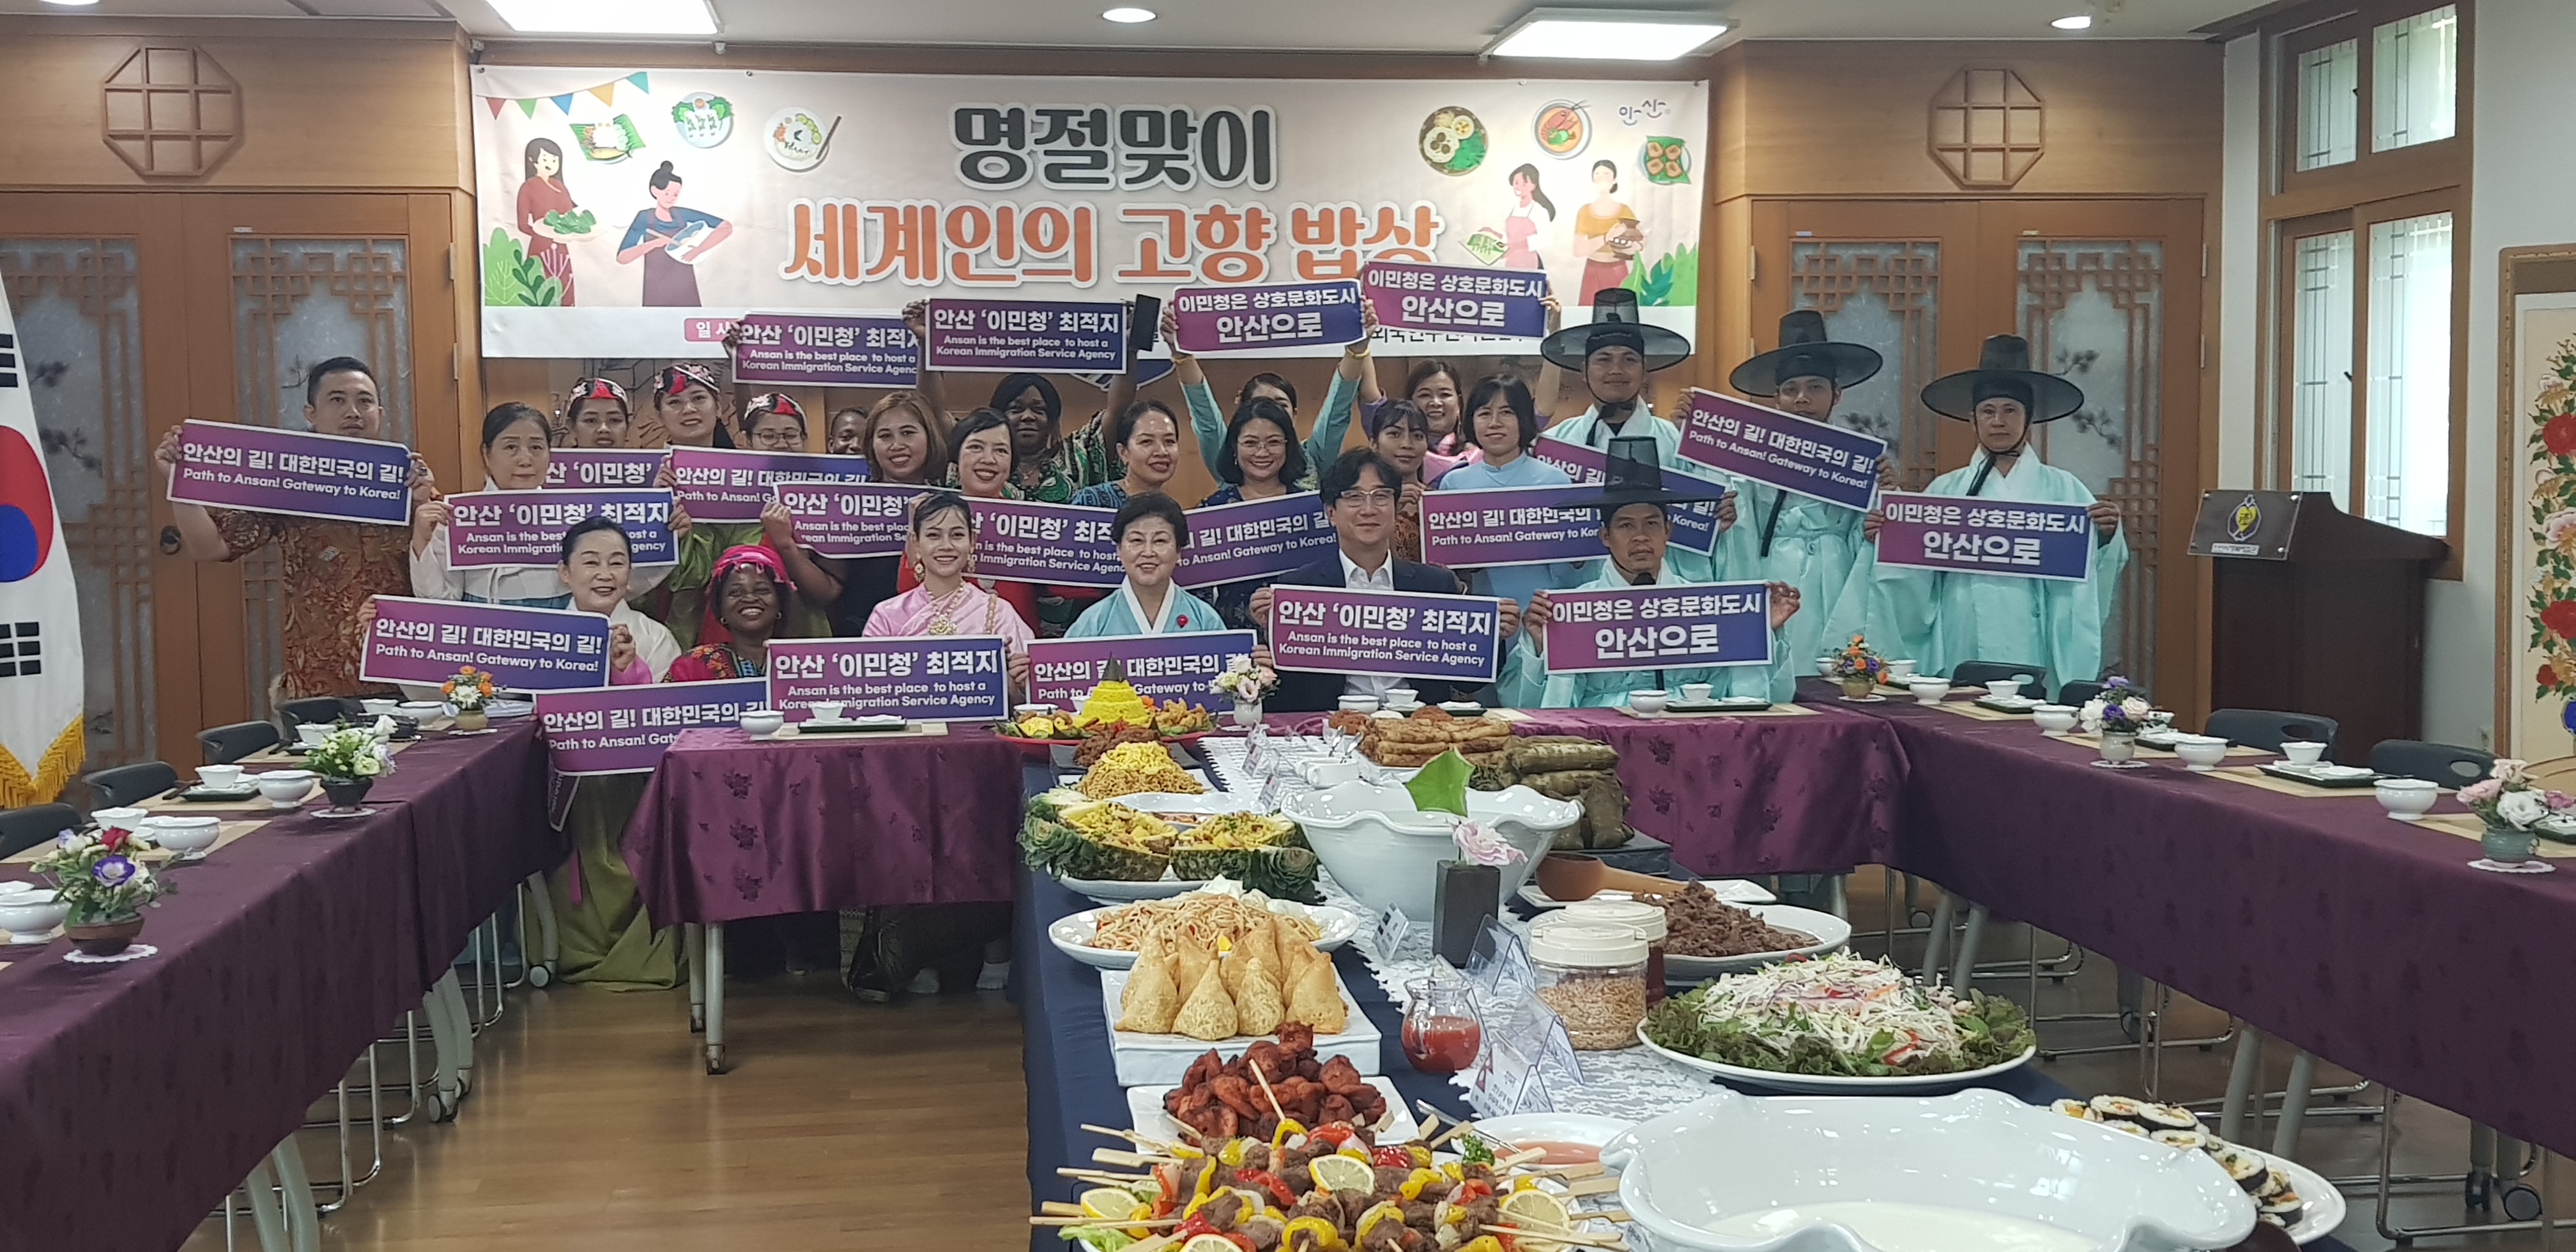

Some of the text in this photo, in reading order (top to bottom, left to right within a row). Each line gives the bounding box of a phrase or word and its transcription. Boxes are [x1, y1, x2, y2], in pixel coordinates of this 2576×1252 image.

[954, 107, 1271, 185] 명절맞이
[785, 204, 1093, 282] 세계인의
[1118, 204, 1271, 283] 고향
[1368, 270, 1543, 298] 이민청은 상호문화도시
[1179, 288, 1356, 312] 이민청은 상호문화도시
[1402, 296, 1505, 327] 안산으로
[934, 309, 976, 330] 안산
[1059, 312, 1118, 333] 최적지
[1216, 312, 1324, 344] 안산으로
[740, 324, 782, 345] 안산
[944, 335, 976, 344] Ansan
[978, 335, 986, 344] is
[989, 336, 1006, 346] the
[1008, 337, 1030, 346] best
[1032, 338, 1060, 347] place
[1065, 339, 1075, 347] to
[1077, 339, 1100, 347] host
[749, 350, 782, 360] Ansan
[785, 350, 793, 360] is
[795, 351, 812, 360] the
[815, 352, 837, 361] best
[839, 352, 868, 363] place
[872, 353, 882, 362] to
[884, 354, 907, 363] host
[937, 346, 1116, 360] Korean Immigration Service Agency
[742, 361, 883, 374] Korean Immigration Service
[1692, 409, 1875, 474] 안산의 길! 대한민국의 길!
[183, 442, 404, 484] 안산의 길! 대한민국의 길!
[1689, 431, 1867, 489] Path Ansan! Gateway Korea!
[183, 468, 401, 500] Path to Ansan! Gateway to Korea!
[675, 468, 753, 487] 안산의 길!
[707, 492, 718, 501] to
[721, 491, 760, 502] Ansan!
[784, 492, 828, 515] 안산
[454, 506, 502, 526] 안산
[794, 521, 885, 531] Ansan is the best
[1428, 510, 1505, 530] 안산의 길!
[1673, 514, 1710, 531] Korea!
[1886, 503, 2085, 534] 이민청은 상호문화도시
[466, 531, 657, 542] Ansan is the a
[828, 533, 893, 545] Immigration
[1199, 528, 1222, 547] 길!
[1227, 514, 1308, 543] 대한민국의
[1432, 528, 1579, 546] Path to Ansan! Gateway to
[458, 544, 501, 554] Korean
[985, 540, 994, 551] is
[997, 540, 1013, 553] the
[1016, 543, 1041, 554] best
[1043, 546, 1075, 557] place
[1080, 549, 1091, 558] to
[1092, 549, 1117, 560] host
[1192, 533, 1337, 565] Ansan! Gateway to Korea!
[1923, 531, 2041, 566] 안산으로
[980, 553, 1046, 567] Immigration
[1049, 558, 1090, 571] Service
[1278, 600, 1326, 627] 안산
[1422, 609, 1491, 636] 최적지
[1553, 593, 1760, 623] 이민청은 상호문화도시
[376, 618, 602, 655] 안산의 길! 대한민국의 길!
[1287, 630, 1476, 652] Ansan is the best place to host a
[1595, 623, 1719, 660] 안산으로
[376, 643, 599, 672] Path to Ansan! Gateway to Korea!
[775, 654, 825, 680] 안산
[926, 650, 998, 675] 최적지
[1034, 660, 1091, 682] 안산의
[1127, 654, 1220, 678] 대한민국의
[1279, 644, 1485, 668] Korean Immigration Service Agency
[788, 681, 976, 696] Ansan the best place host
[901, 694, 995, 706] Service Agency
[1038, 683, 1190, 699] Path Gateway
[544, 710, 603, 733] 안산의
[610, 709, 636, 728] 길!
[642, 702, 740, 727] 대한민국의
[549, 738, 579, 750] Path
[599, 733, 645, 747] Ansan!
